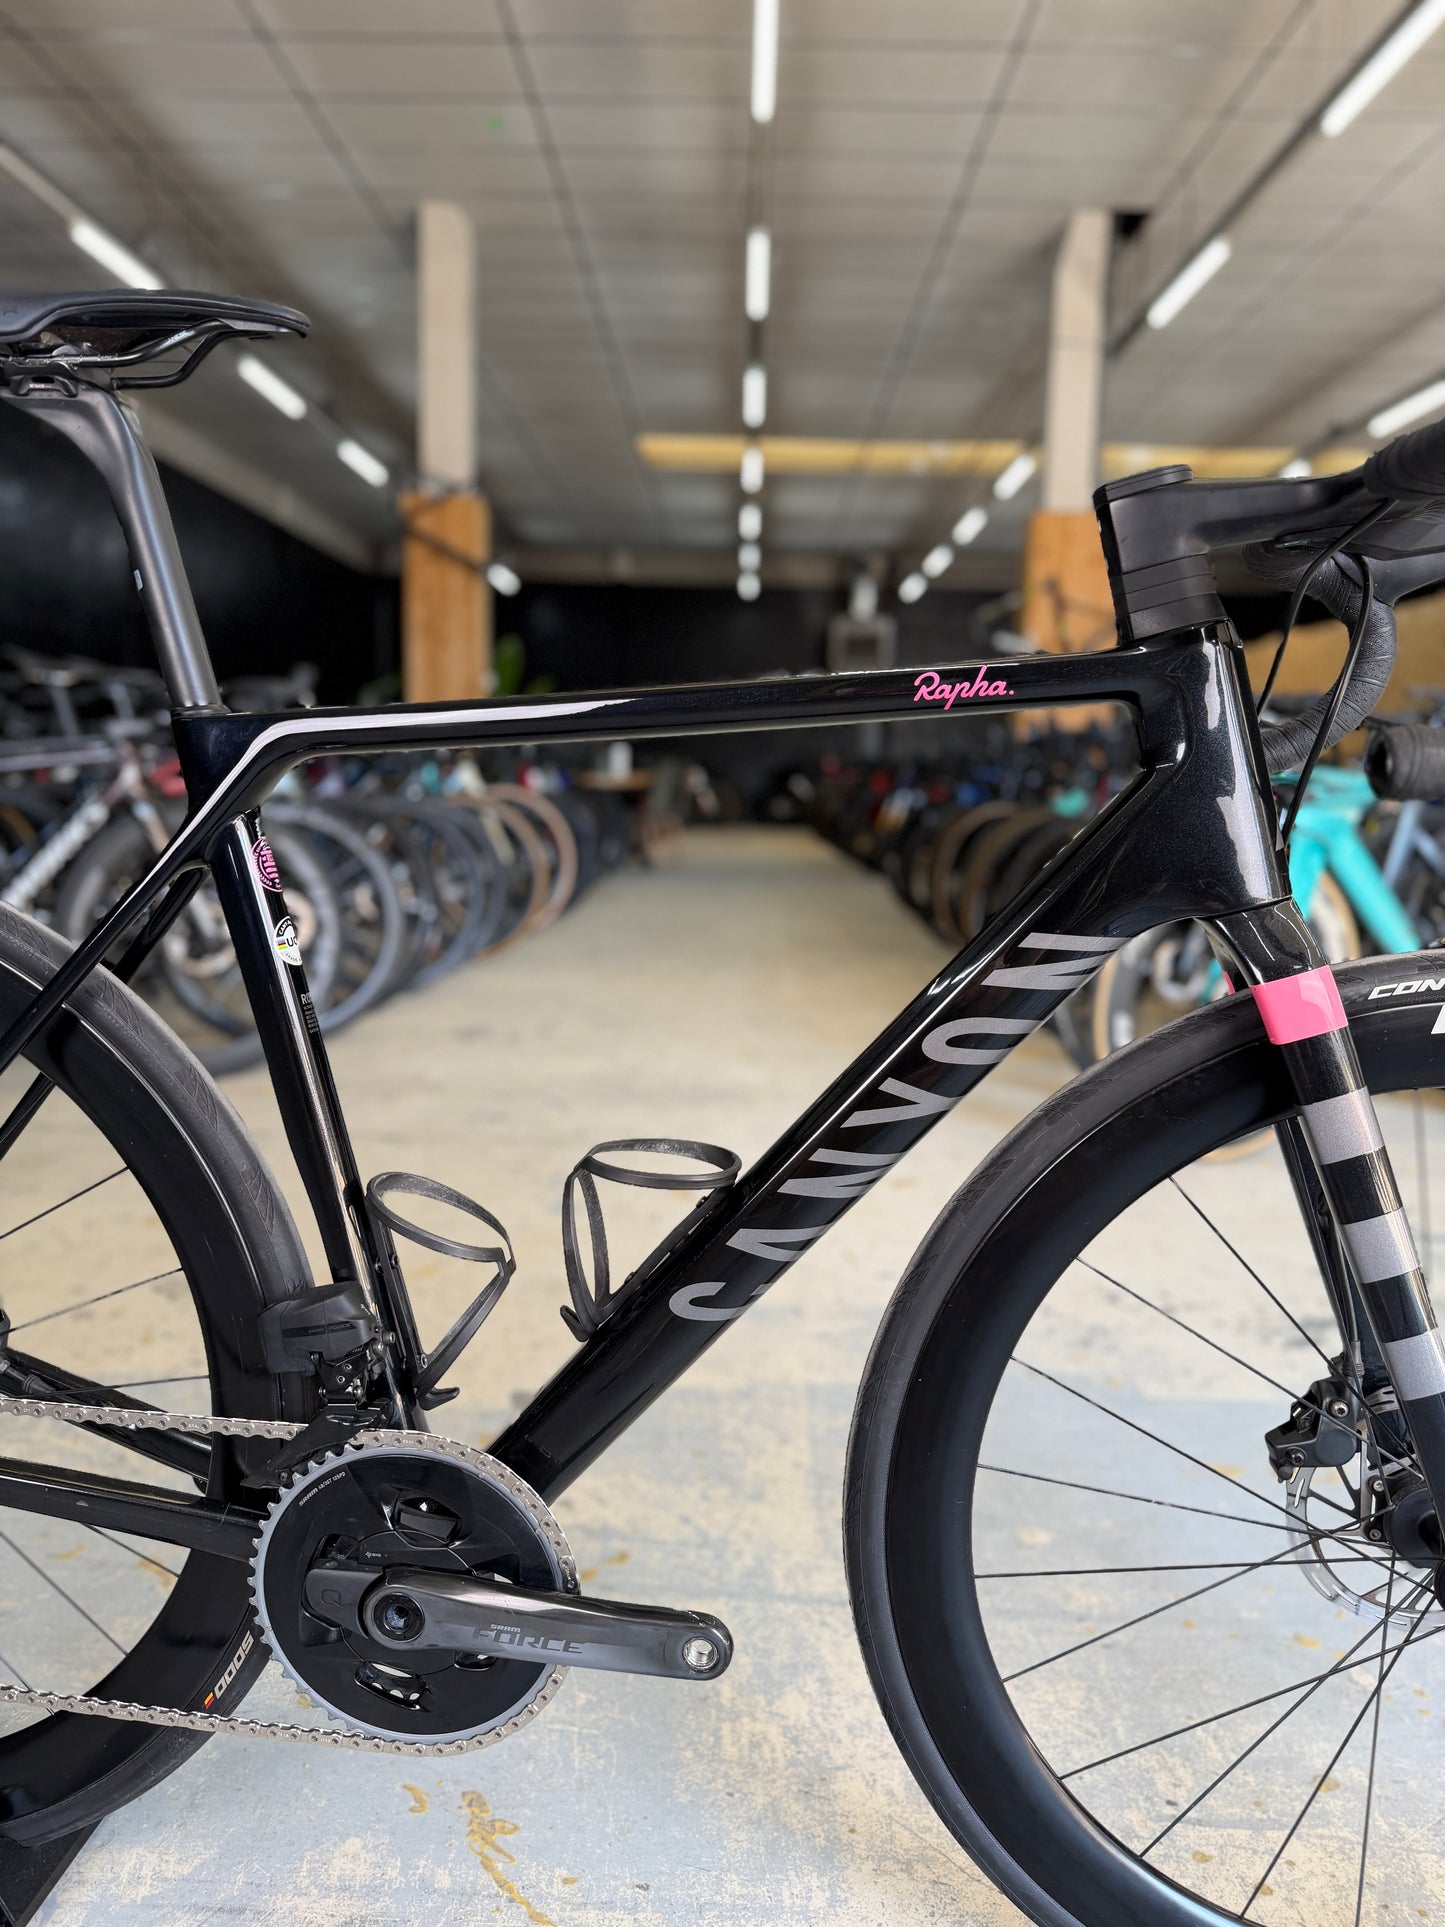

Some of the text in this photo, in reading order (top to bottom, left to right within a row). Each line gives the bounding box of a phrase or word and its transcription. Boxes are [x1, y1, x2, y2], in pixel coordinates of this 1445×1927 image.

[913, 664, 1015, 711] Rapha.
[668, 932, 1131, 1323] CANYON
[472, 1627, 583, 1654] FORCE
[490, 1623, 521, 1633] SRAM
[214, 1629, 255, 1699] 5000
